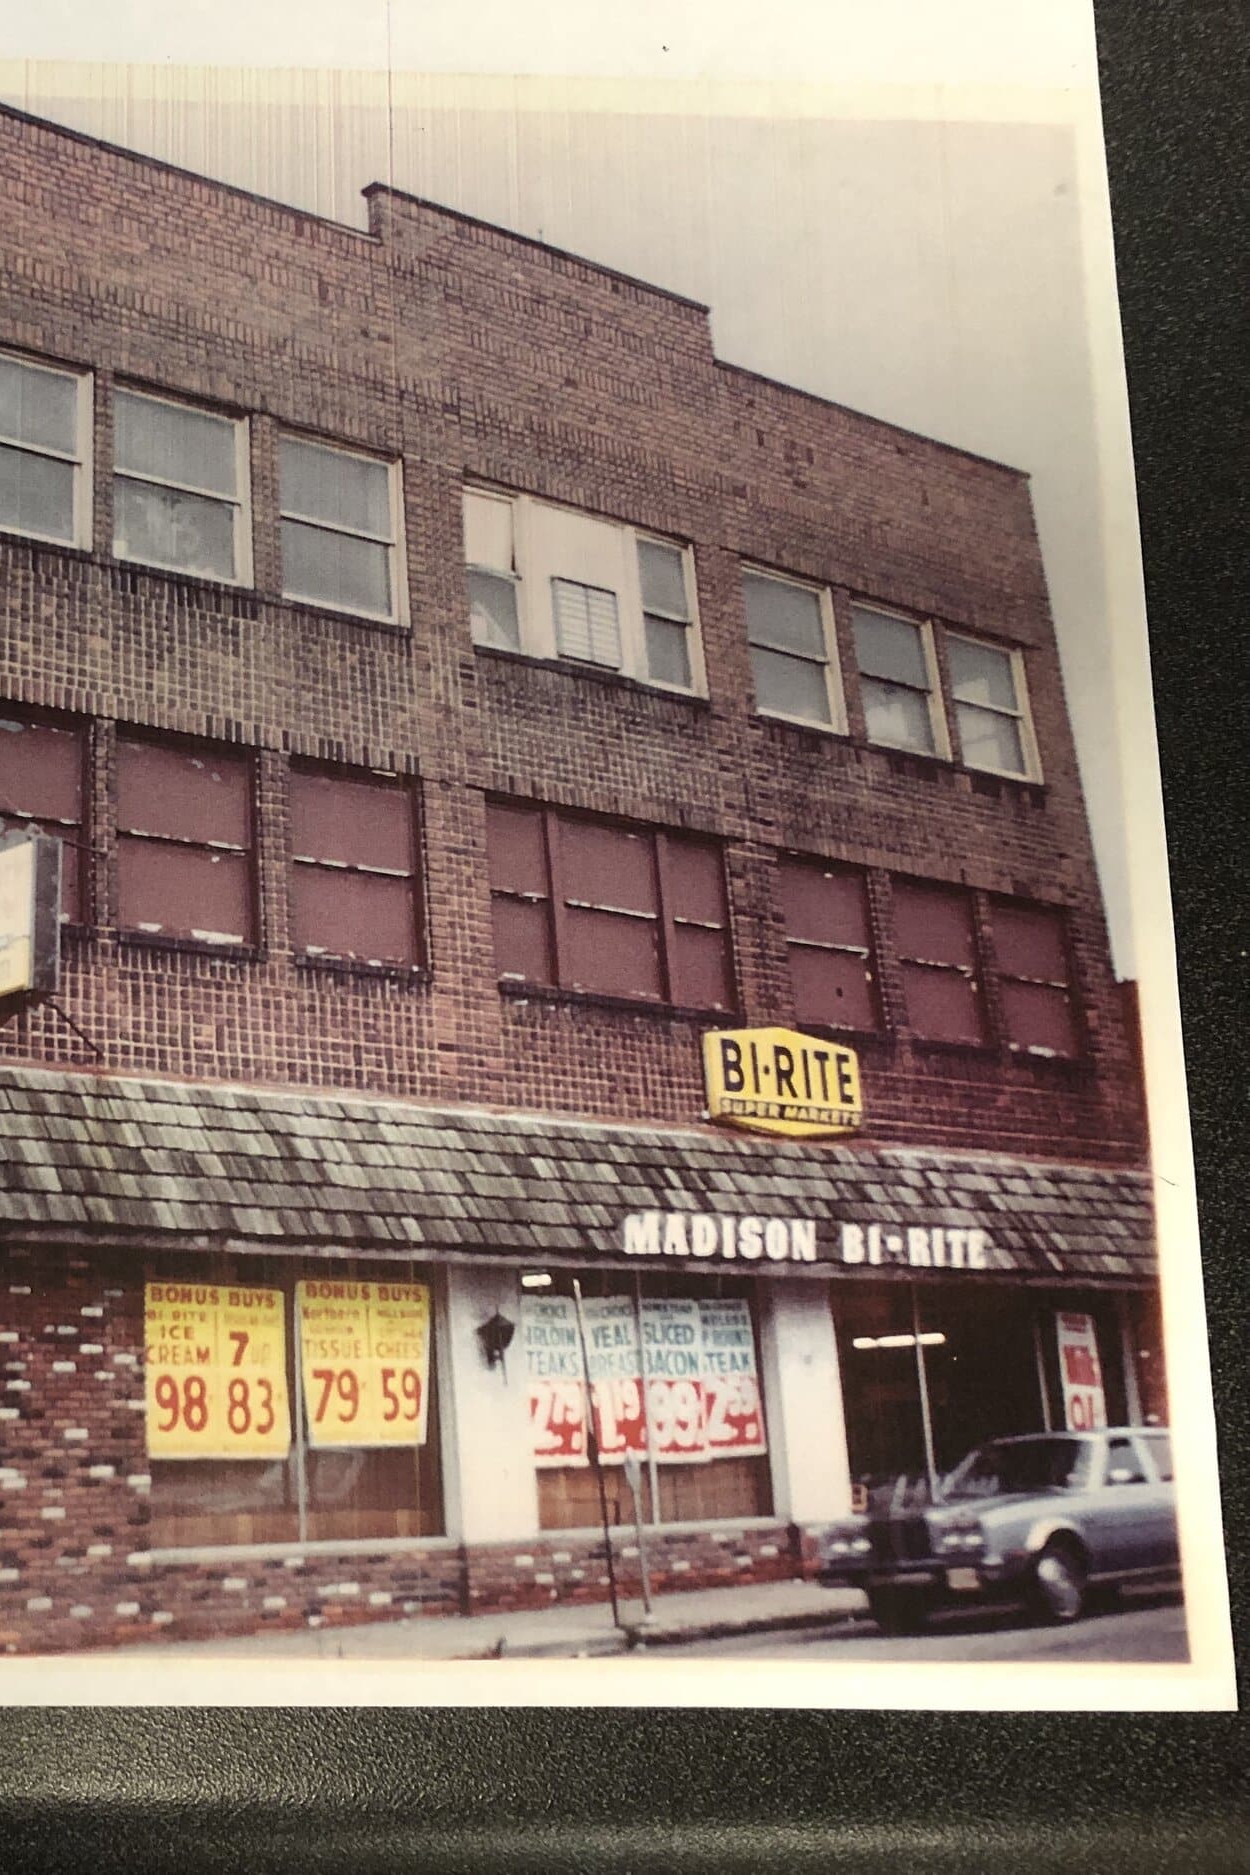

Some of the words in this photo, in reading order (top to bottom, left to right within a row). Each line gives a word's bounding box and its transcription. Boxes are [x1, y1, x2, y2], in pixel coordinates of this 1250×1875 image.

[721, 1099, 780, 1118] SUPER
[623, 1212, 816, 1262] MADISON
[150, 1286, 220, 1306] BONUS
[229, 1291, 276, 1309] BUYS
[305, 1282, 371, 1301] BONUS
[378, 1286, 422, 1303] BUYS
[160, 1325, 194, 1340] ICE
[591, 1324, 632, 1349] VEAL
[643, 1322, 695, 1346] SLICED
[145, 1344, 211, 1366] CREAM
[229, 1330, 250, 1367] 7
[303, 1339, 362, 1360] TISSUE
[155, 1373, 210, 1433] 98
[227, 1376, 276, 1436] 83
[311, 1367, 361, 1423] 79
[380, 1367, 422, 1422] 59
